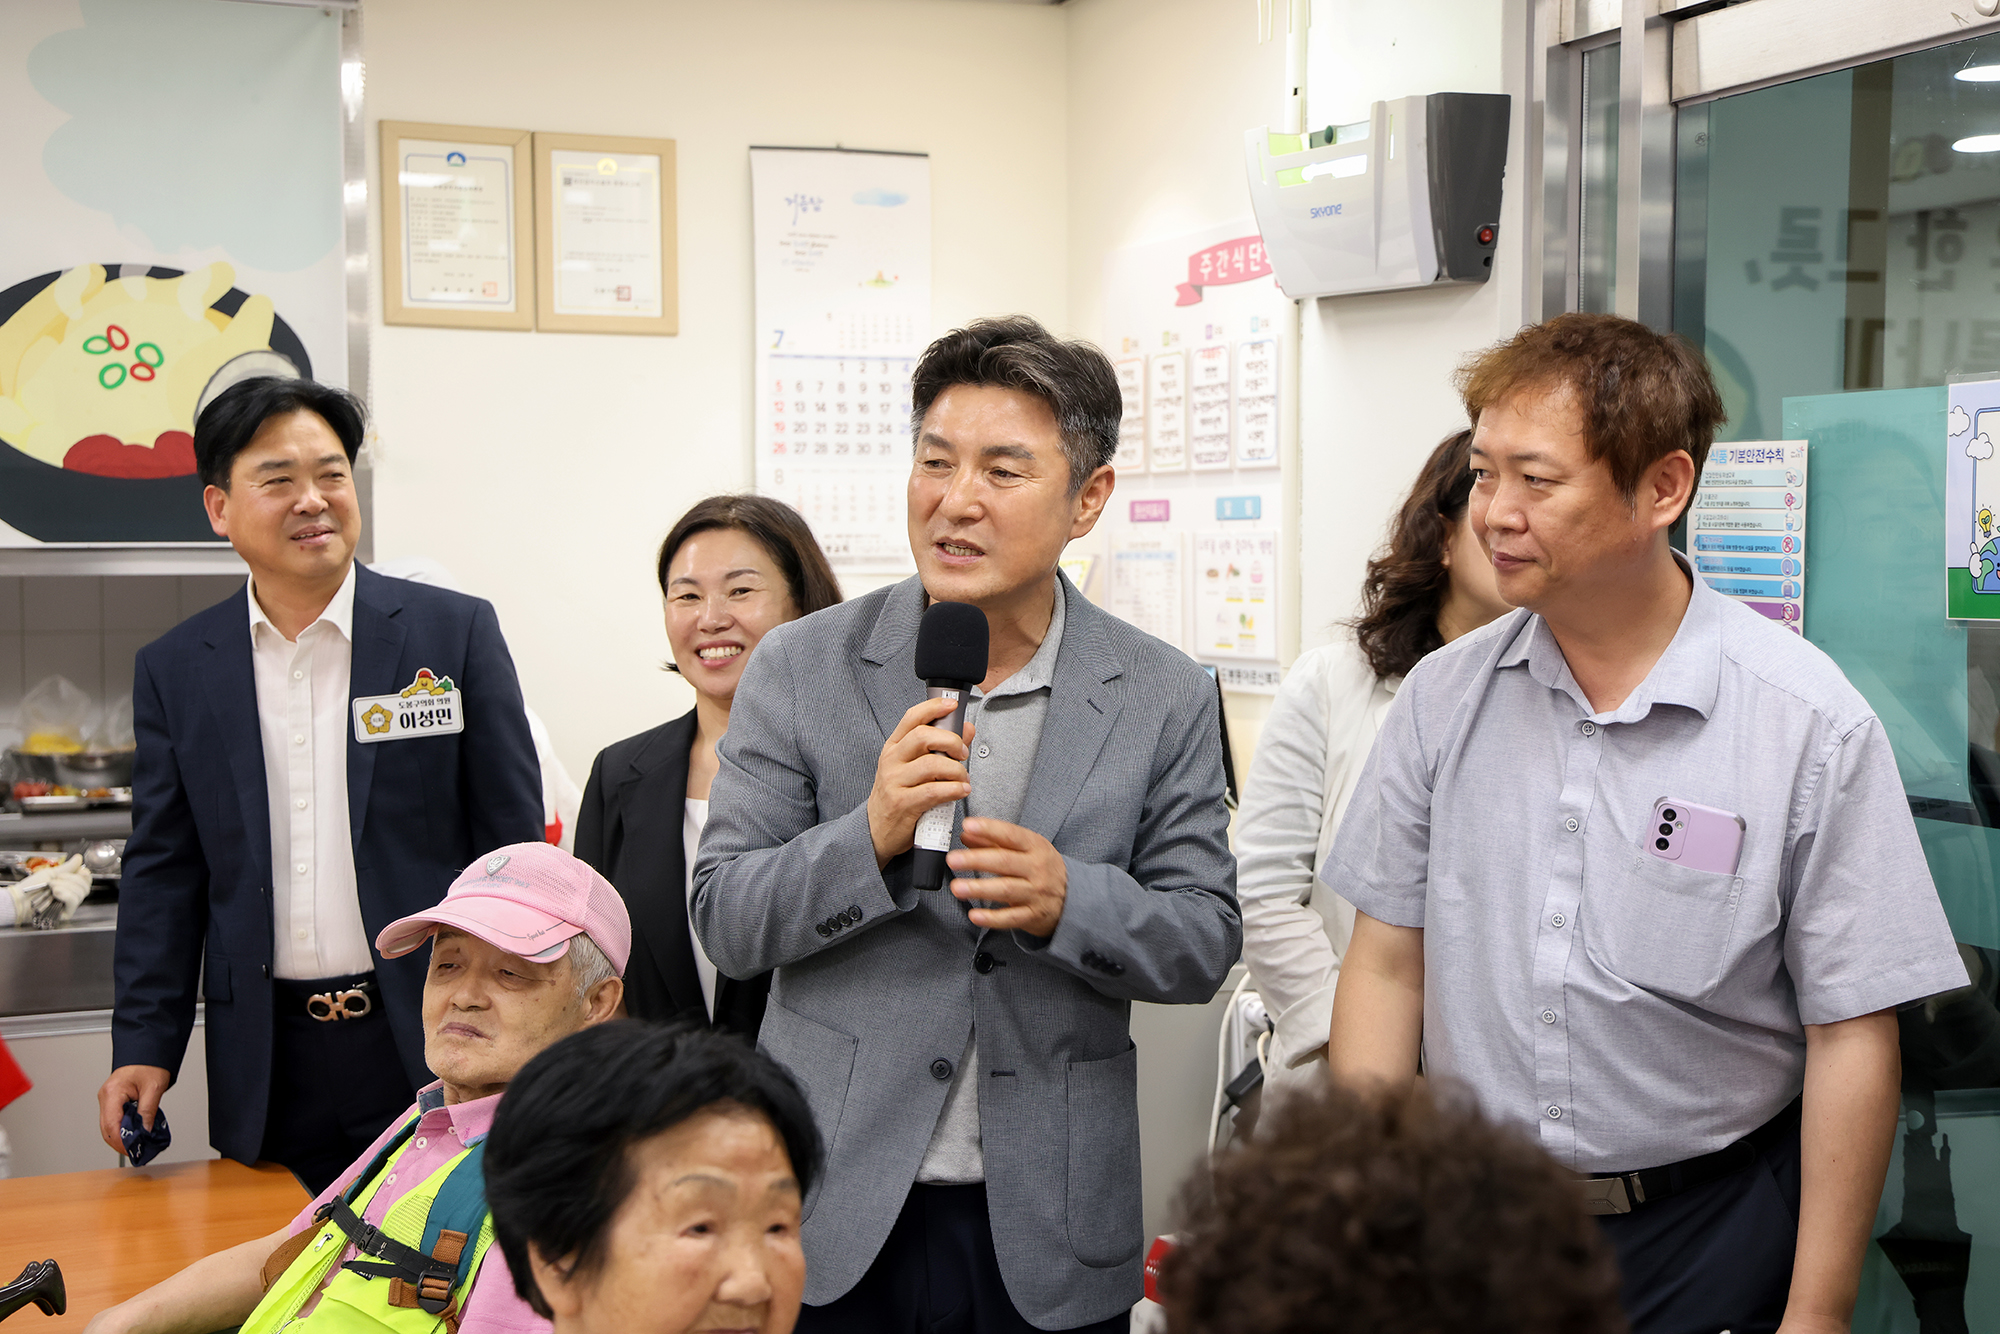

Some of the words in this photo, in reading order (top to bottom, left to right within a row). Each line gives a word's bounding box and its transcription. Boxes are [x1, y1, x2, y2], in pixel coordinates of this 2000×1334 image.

[1199, 242, 1271, 282] 주간식단
[773, 329, 784, 347] 7
[775, 380, 783, 392] 5
[879, 382, 892, 395] 10
[815, 402, 826, 413] 14
[794, 421, 808, 434] 20
[815, 422, 827, 434] 21
[835, 422, 849, 435] 22
[856, 422, 870, 435] 23
[878, 422, 893, 435] 24
[794, 442, 807, 454] 27
[1710, 449, 1728, 464] 식품
[1729, 448, 1784, 464] 기본안전수칙
[398, 699, 434, 708] 도봉구의회
[400, 708, 453, 729] 이성민
